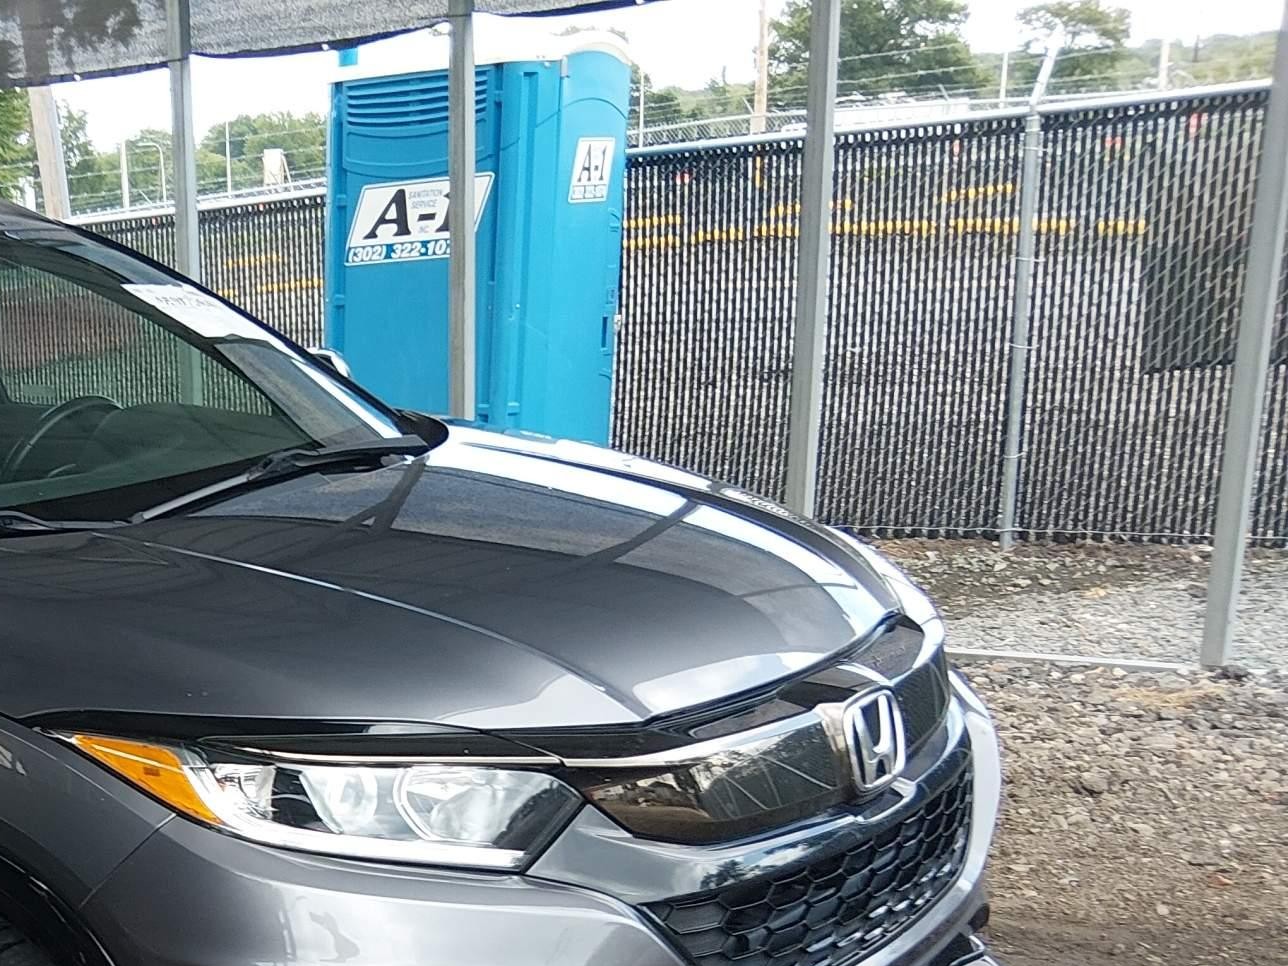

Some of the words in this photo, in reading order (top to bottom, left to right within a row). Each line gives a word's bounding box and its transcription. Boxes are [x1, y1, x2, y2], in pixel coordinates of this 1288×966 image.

[577, 143, 608, 183] A-1
[348, 245, 387, 263] (302)
[390, 239, 450, 259] 322-10
